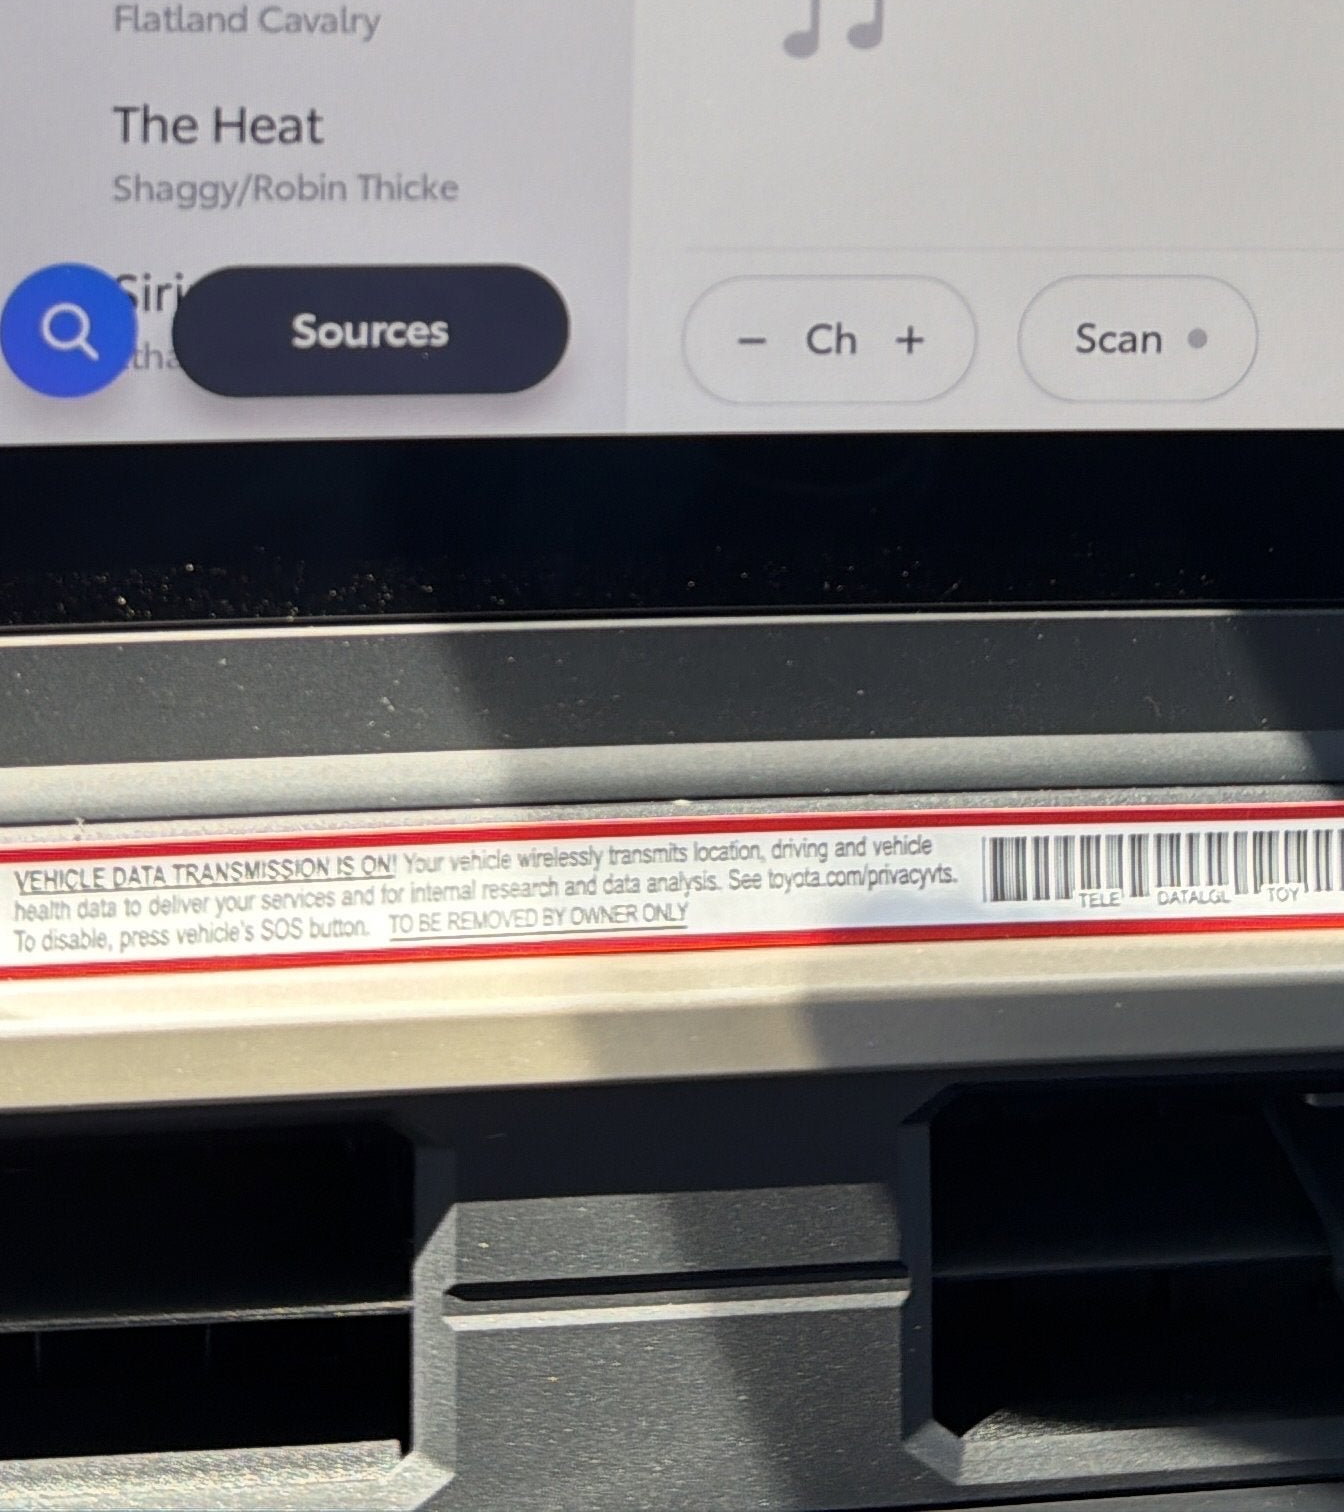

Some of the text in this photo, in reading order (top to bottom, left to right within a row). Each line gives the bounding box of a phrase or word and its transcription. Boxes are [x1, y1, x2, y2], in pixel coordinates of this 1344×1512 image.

[112, 3, 382, 44] Flatland Cavalry
[111, 104, 324, 146] The Heat
[111, 172, 461, 212] Shaggy/Robin Thicke
[290, 311, 451, 350] Sources
[805, 321, 858, 357] Ch
[1074, 321, 1163, 356] Scan
[15, 868, 106, 891] VEHICLE
[114, 865, 166, 887] DATA
[173, 857, 330, 884] TRANSMISSION
[337, 857, 354, 875] IS
[404, 853, 444, 874] Your
[450, 850, 511, 871] vehicle
[518, 847, 603, 871] wirelessly
[609, 844, 687, 865] transmits
[694, 841, 765, 862] location,
[772, 837, 828, 862] driving
[835, 837, 866, 857] and
[873, 835, 933, 855] vehicle
[16, 900, 70, 922] health
[78, 897, 116, 919] data
[125, 897, 141, 917] to
[149, 893, 208, 915] deliver
[214, 895, 255, 918] your
[261, 889, 335, 909] services
[343, 886, 374, 906] and
[381, 884, 404, 904] for
[411, 881, 476, 903] internal
[482, 877, 557, 898] research
[565, 875, 597, 895] and
[603, 873, 641, 893] data
[647, 870, 721, 897] analysis.
[729, 868, 762, 889] See
[1079, 892, 1121, 907] TELE
[1267, 888, 1300, 902] TOY
[14, 903, 688, 953] To disable, press vehicle's SOS button. TO BE REMOVED BY OWNER ONLY
